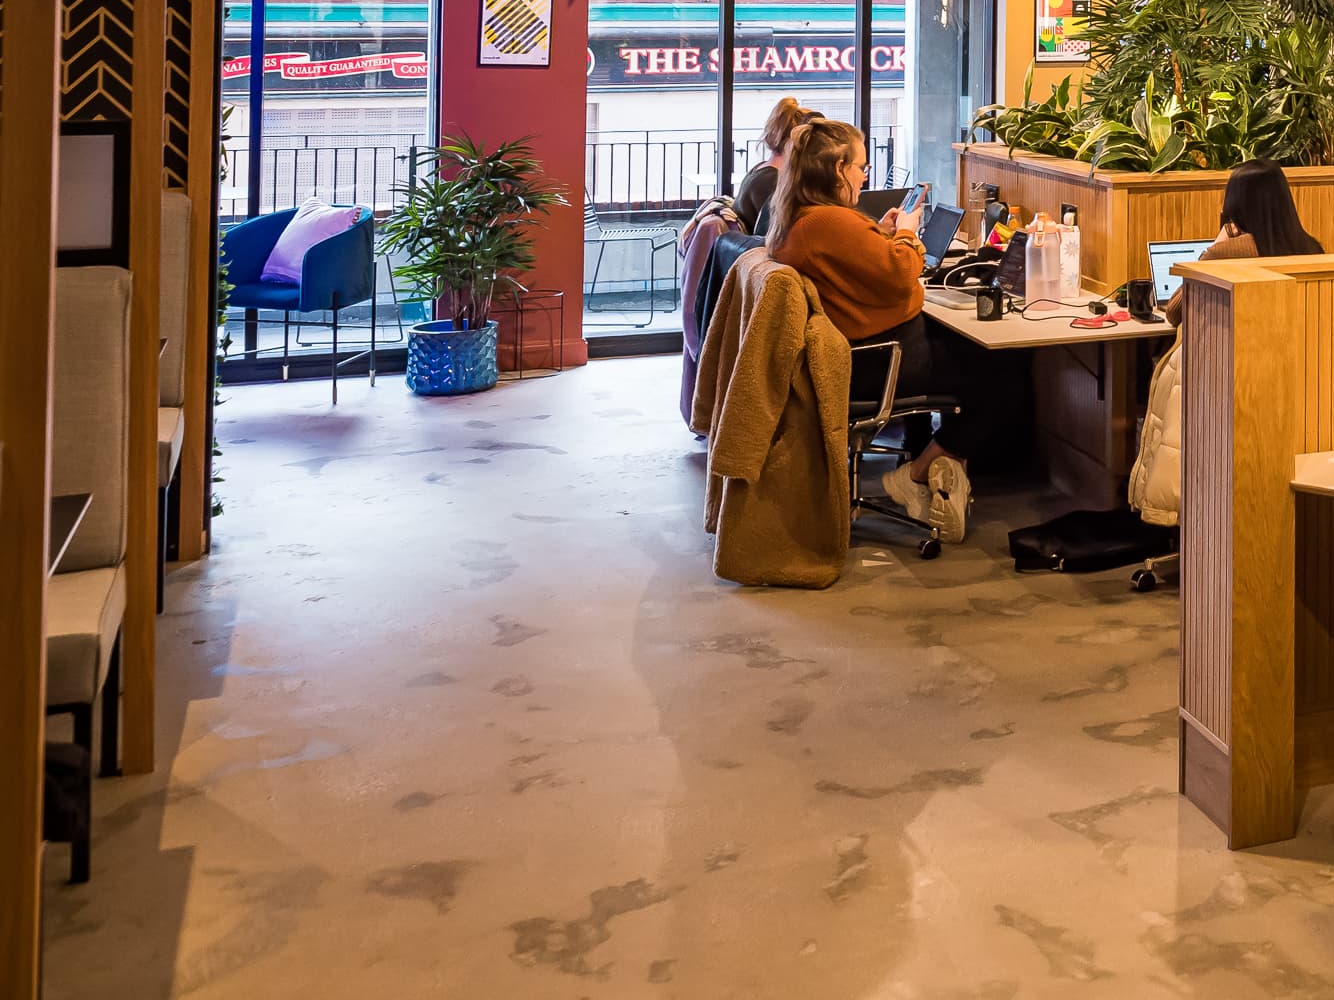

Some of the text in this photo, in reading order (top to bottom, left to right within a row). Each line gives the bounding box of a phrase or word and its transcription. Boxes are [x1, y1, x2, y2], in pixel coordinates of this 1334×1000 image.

[287, 57, 391, 76] QUALITY GUARANTEED
[619, 47, 702, 74] THE
